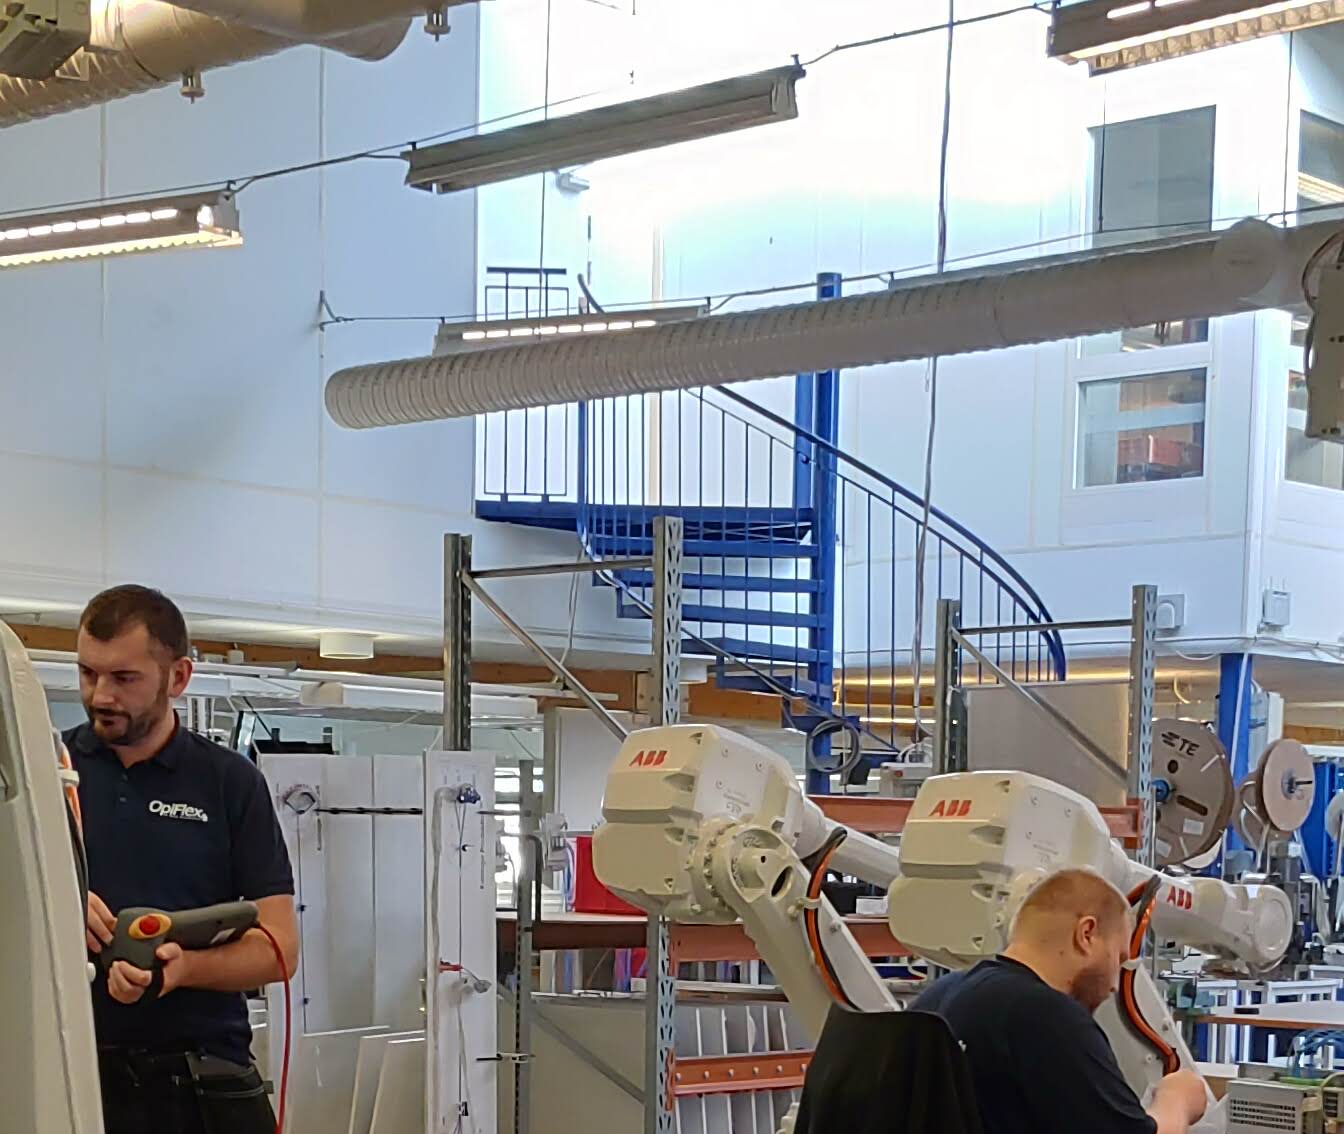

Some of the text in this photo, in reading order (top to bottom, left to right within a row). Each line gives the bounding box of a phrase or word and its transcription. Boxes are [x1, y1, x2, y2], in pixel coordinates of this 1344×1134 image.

[629, 750, 668, 767] ABB
[148, 799, 204, 818] OpiFlex
[929, 799, 972, 817] ABB
[1167, 886, 1192, 910] ABB
